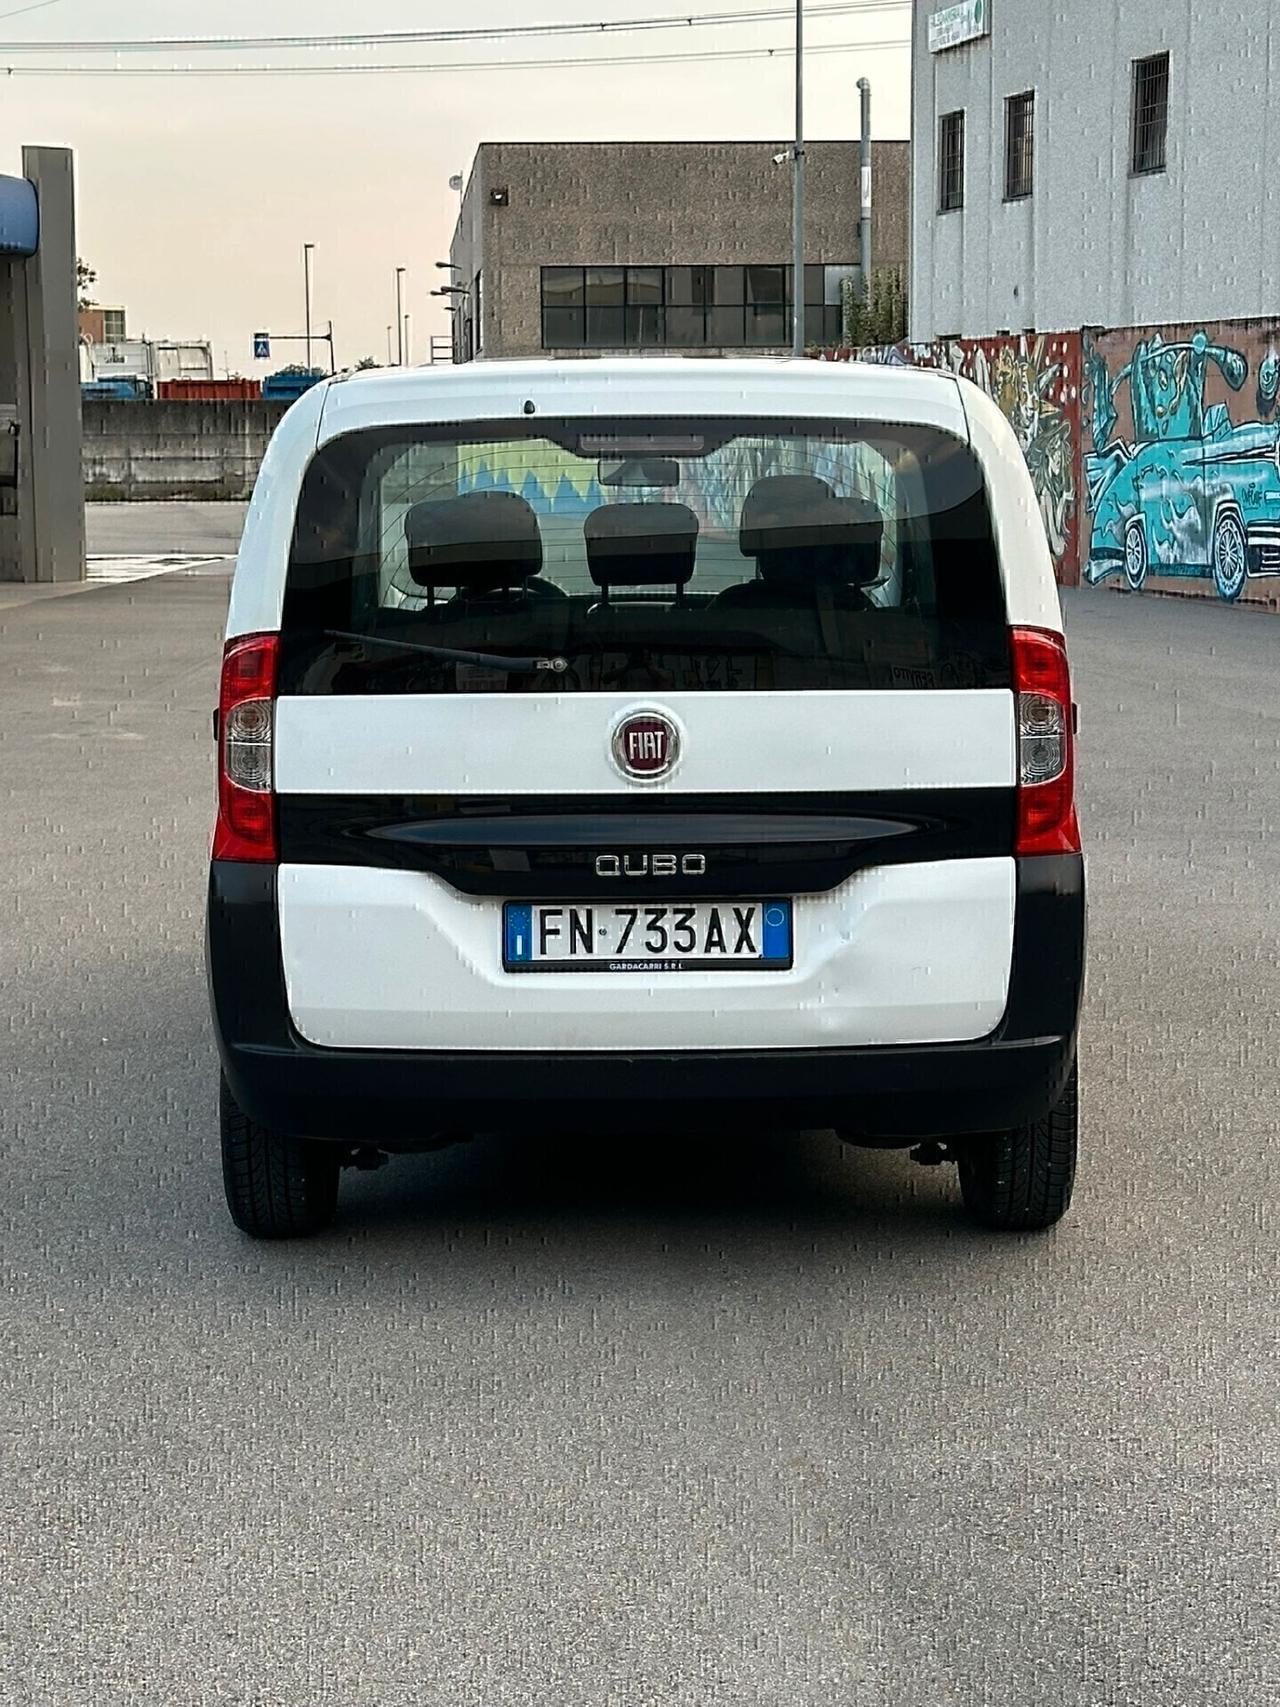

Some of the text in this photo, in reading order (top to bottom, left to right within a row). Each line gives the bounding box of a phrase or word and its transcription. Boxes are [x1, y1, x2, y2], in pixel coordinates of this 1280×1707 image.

[629, 732, 664, 760] FIAT
[596, 855, 706, 876] QUBO
[540, 909, 593, 955] FN
[615, 907, 757, 954] 733AX
